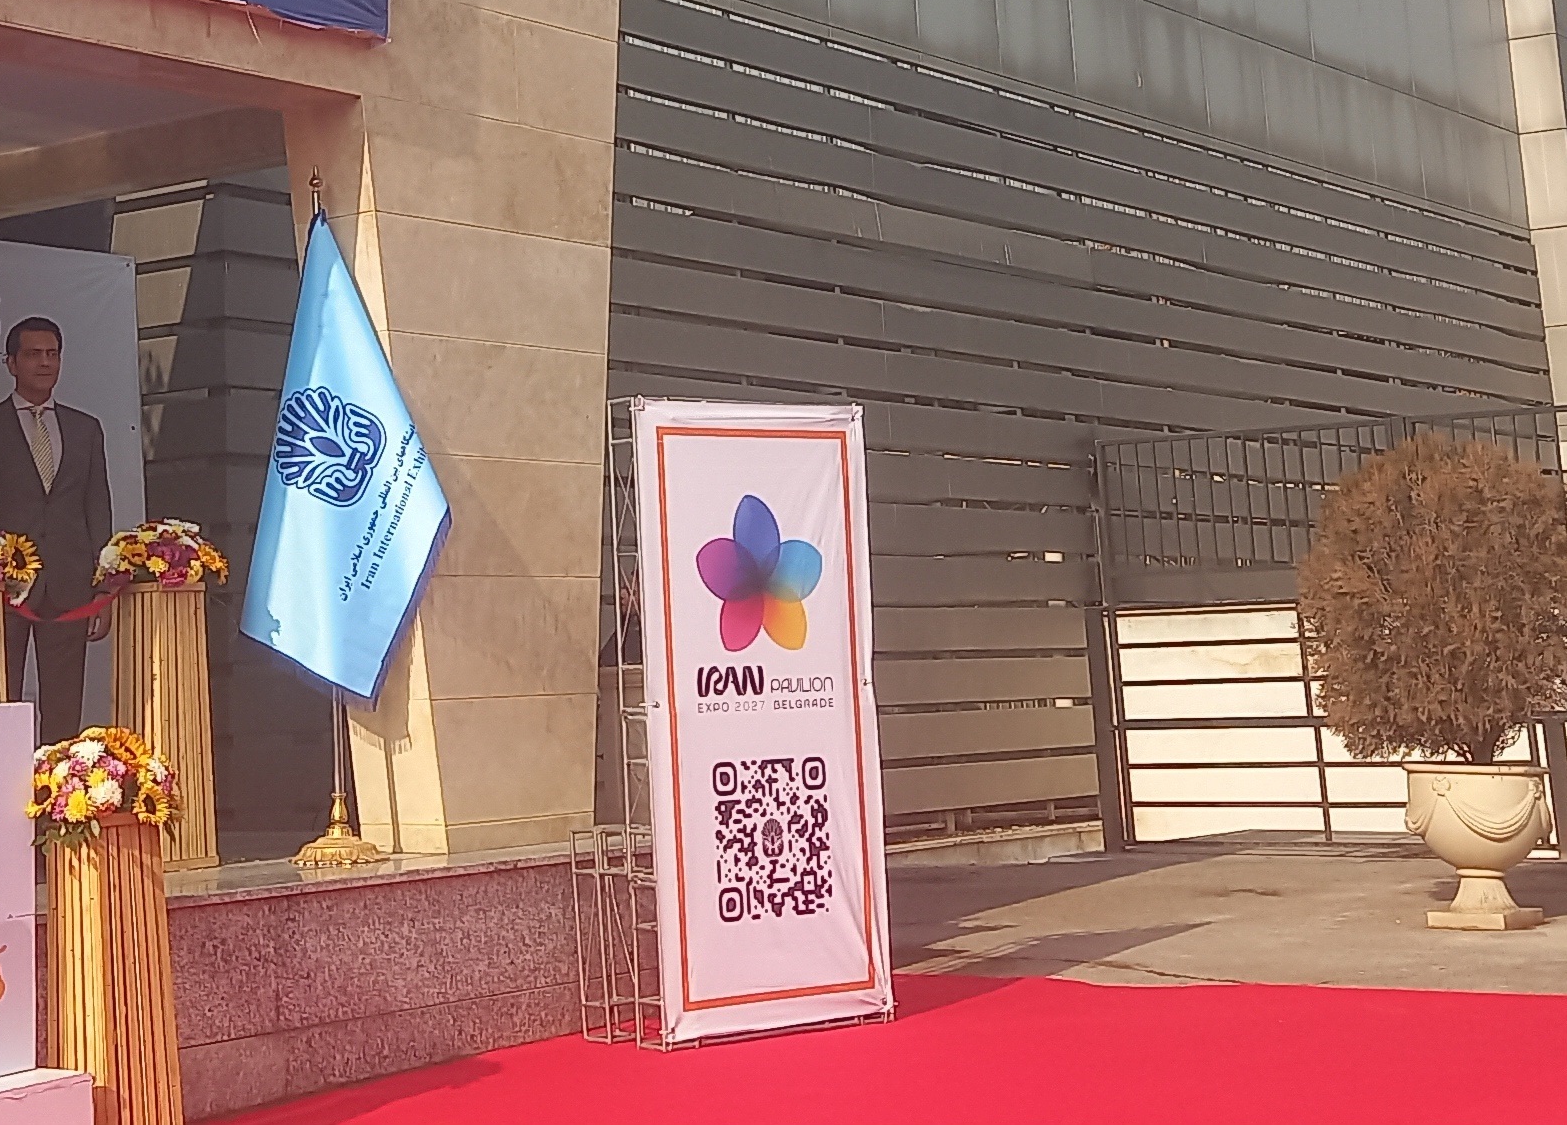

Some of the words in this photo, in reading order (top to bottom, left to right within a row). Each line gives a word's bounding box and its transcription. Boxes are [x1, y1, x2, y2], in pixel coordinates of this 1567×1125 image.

[360, 562, 380, 590] Iran
[373, 480, 413, 560] International
[697, 702, 730, 714] EXPO
[734, 700, 766, 712] 2027
[773, 697, 834, 710] BELGRADE
